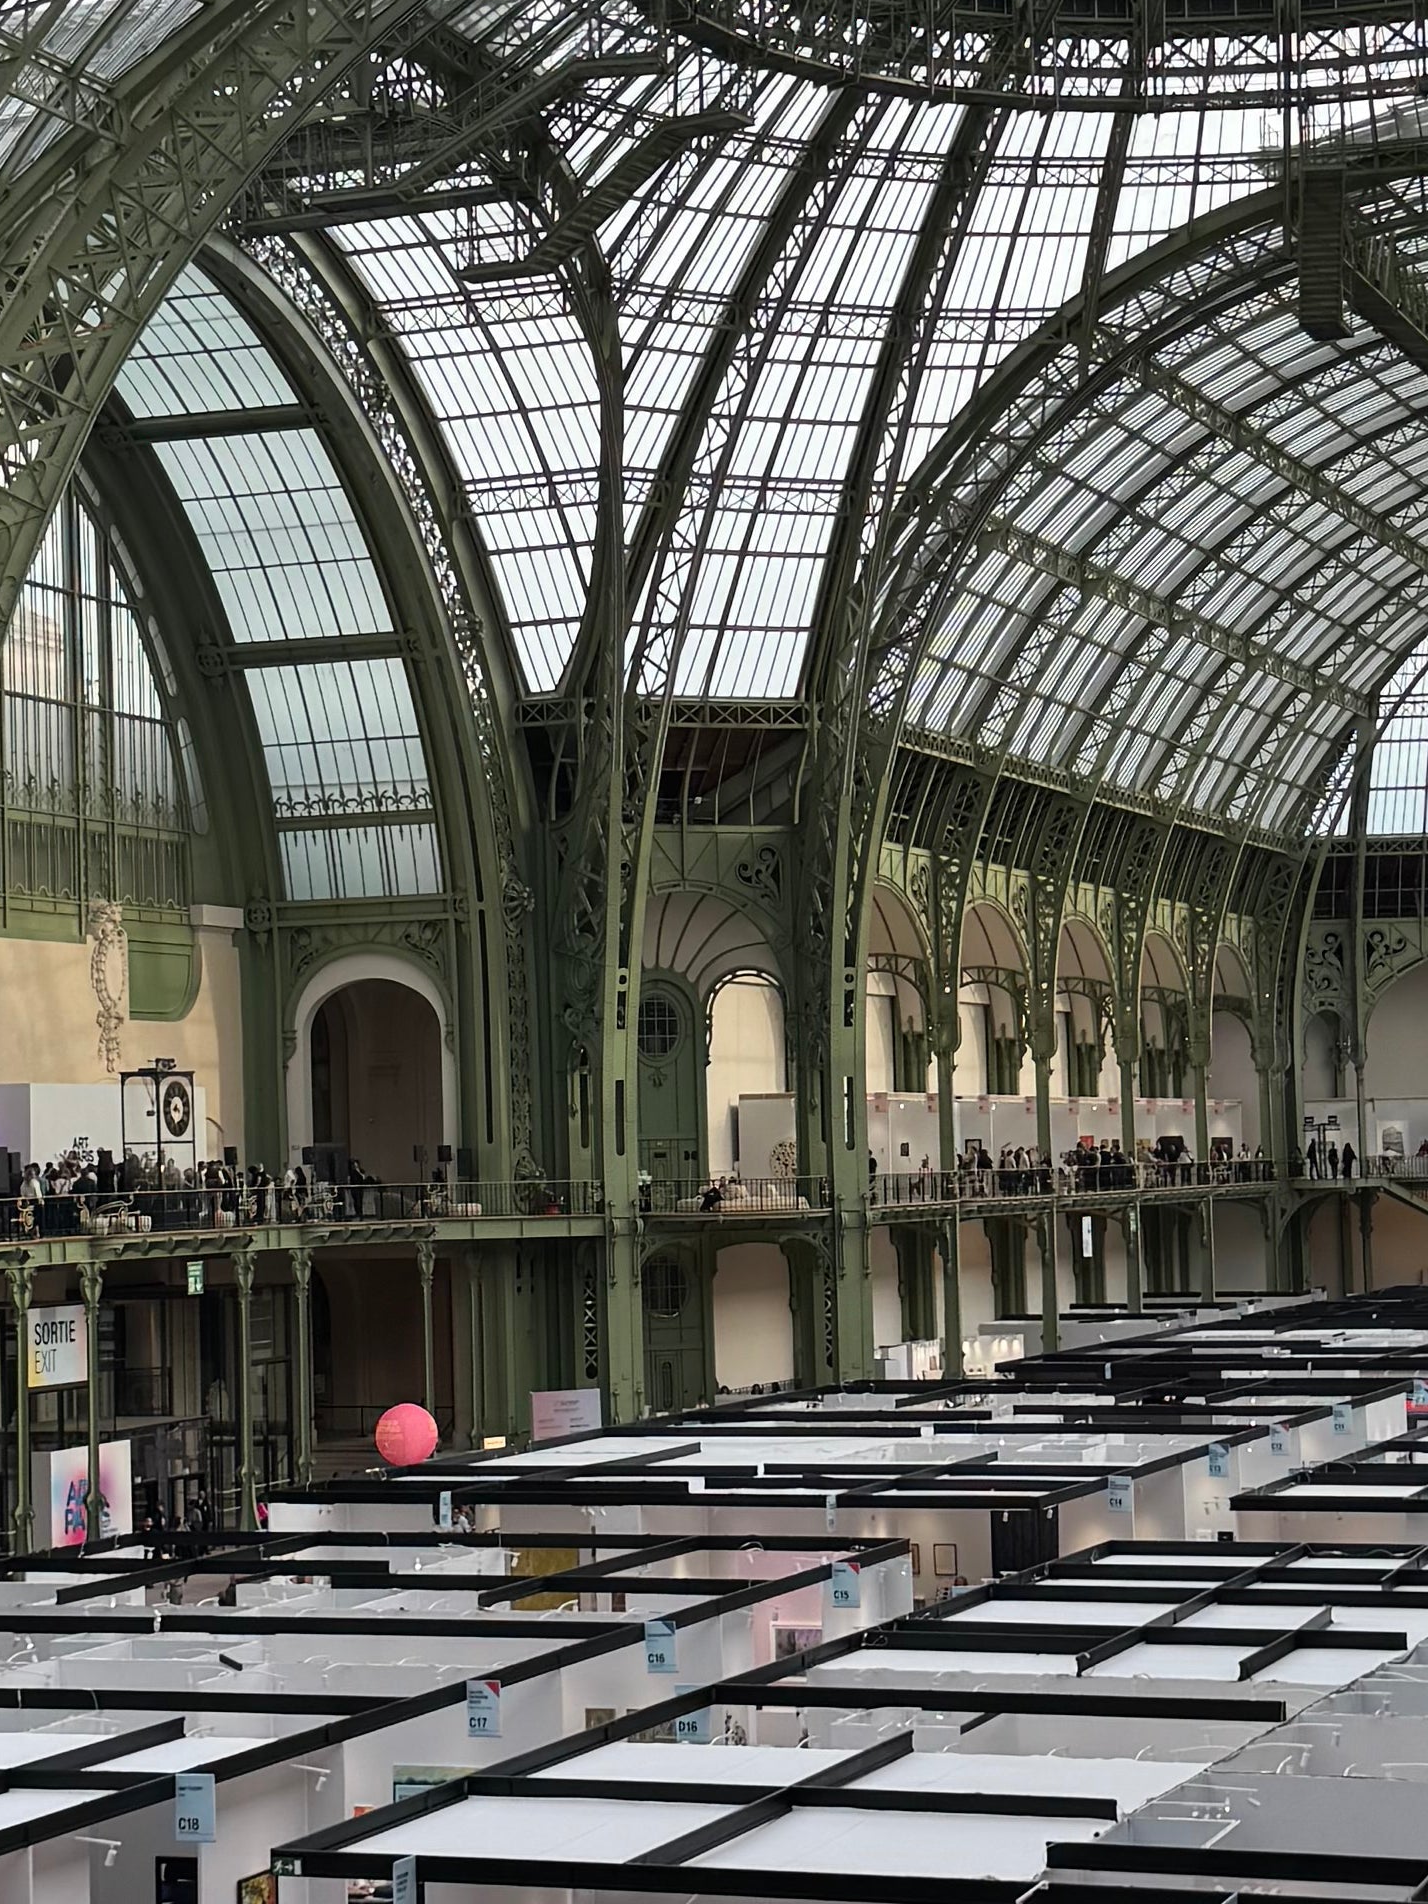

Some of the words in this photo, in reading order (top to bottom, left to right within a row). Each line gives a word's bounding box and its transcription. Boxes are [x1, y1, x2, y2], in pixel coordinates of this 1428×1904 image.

[72, 1137, 89, 1149] ART
[34, 1320, 77, 1346] SORTIE
[35, 1348, 57, 1374] EXIT
[833, 1590, 850, 1600] C15
[647, 1653, 665, 1664] C16
[469, 1716, 488, 1728] C17
[678, 1720, 698, 1733] D16
[178, 1817, 200, 1831] C18
